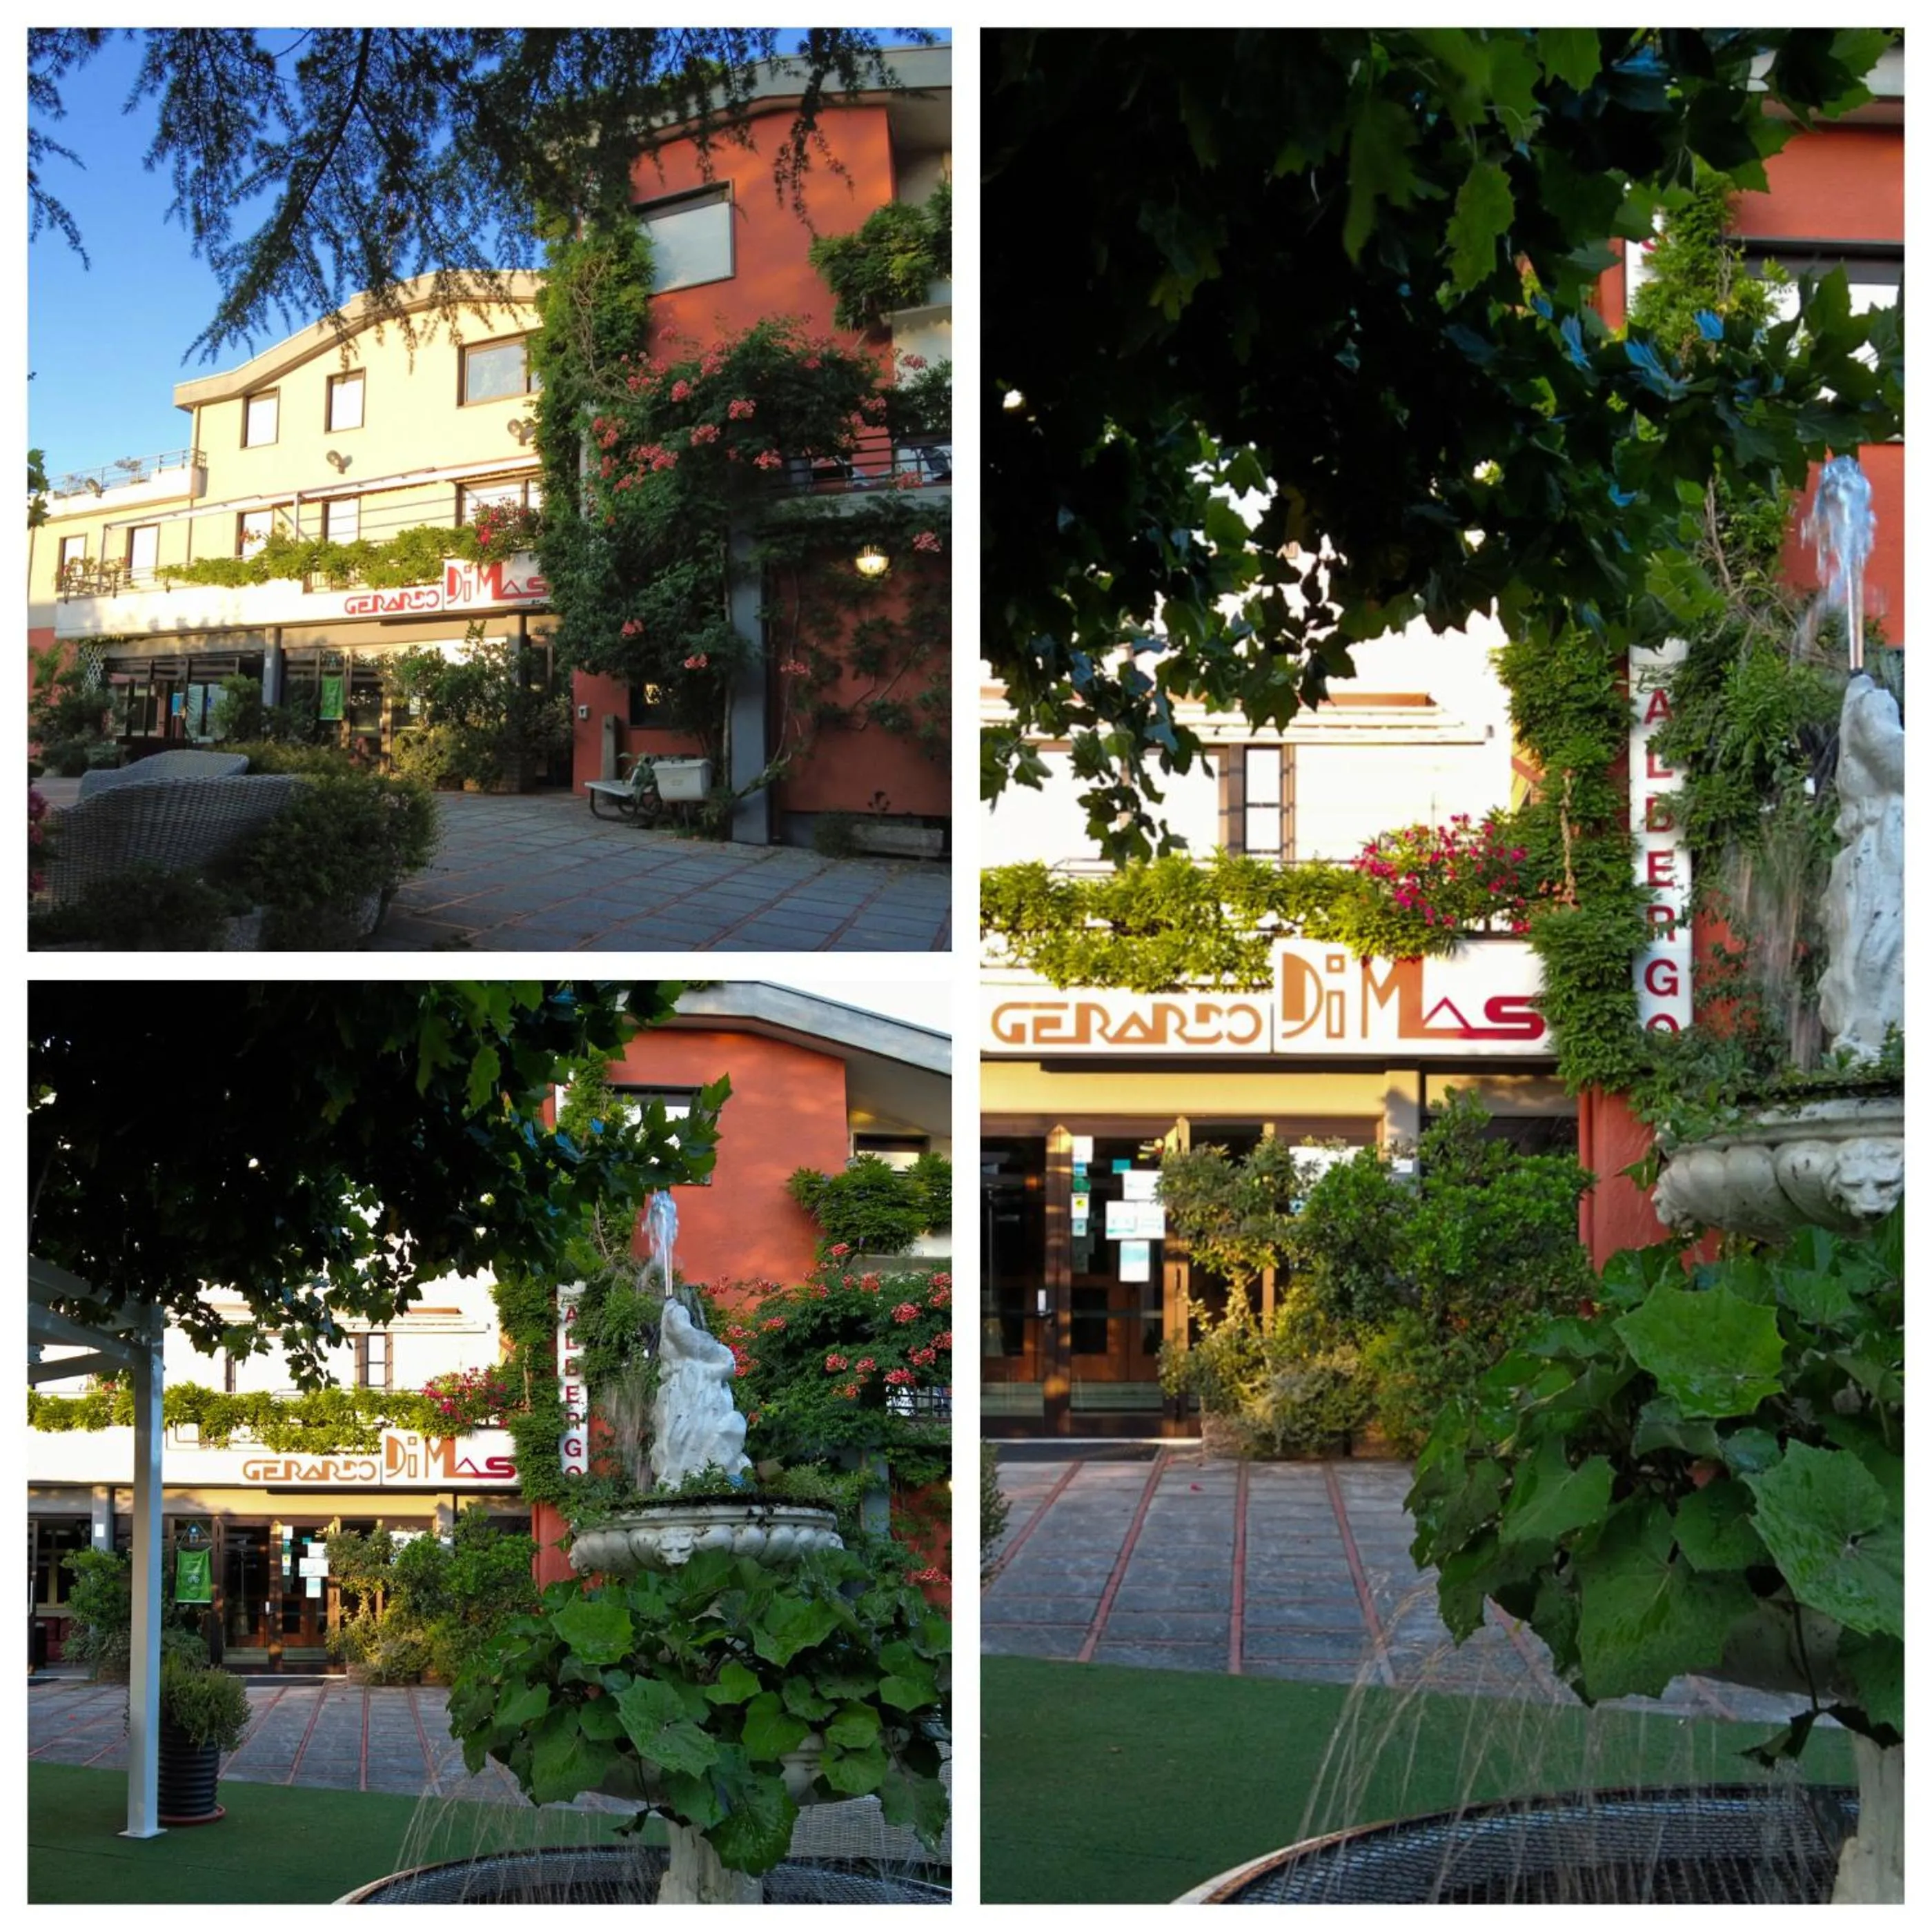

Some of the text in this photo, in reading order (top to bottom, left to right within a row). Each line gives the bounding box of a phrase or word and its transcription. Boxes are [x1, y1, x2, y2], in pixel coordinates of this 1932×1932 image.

[344, 589, 440, 615] GERARDO
[991, 1001, 1263, 1045] GERARDO
[243, 1459, 377, 1481] GERARDO
